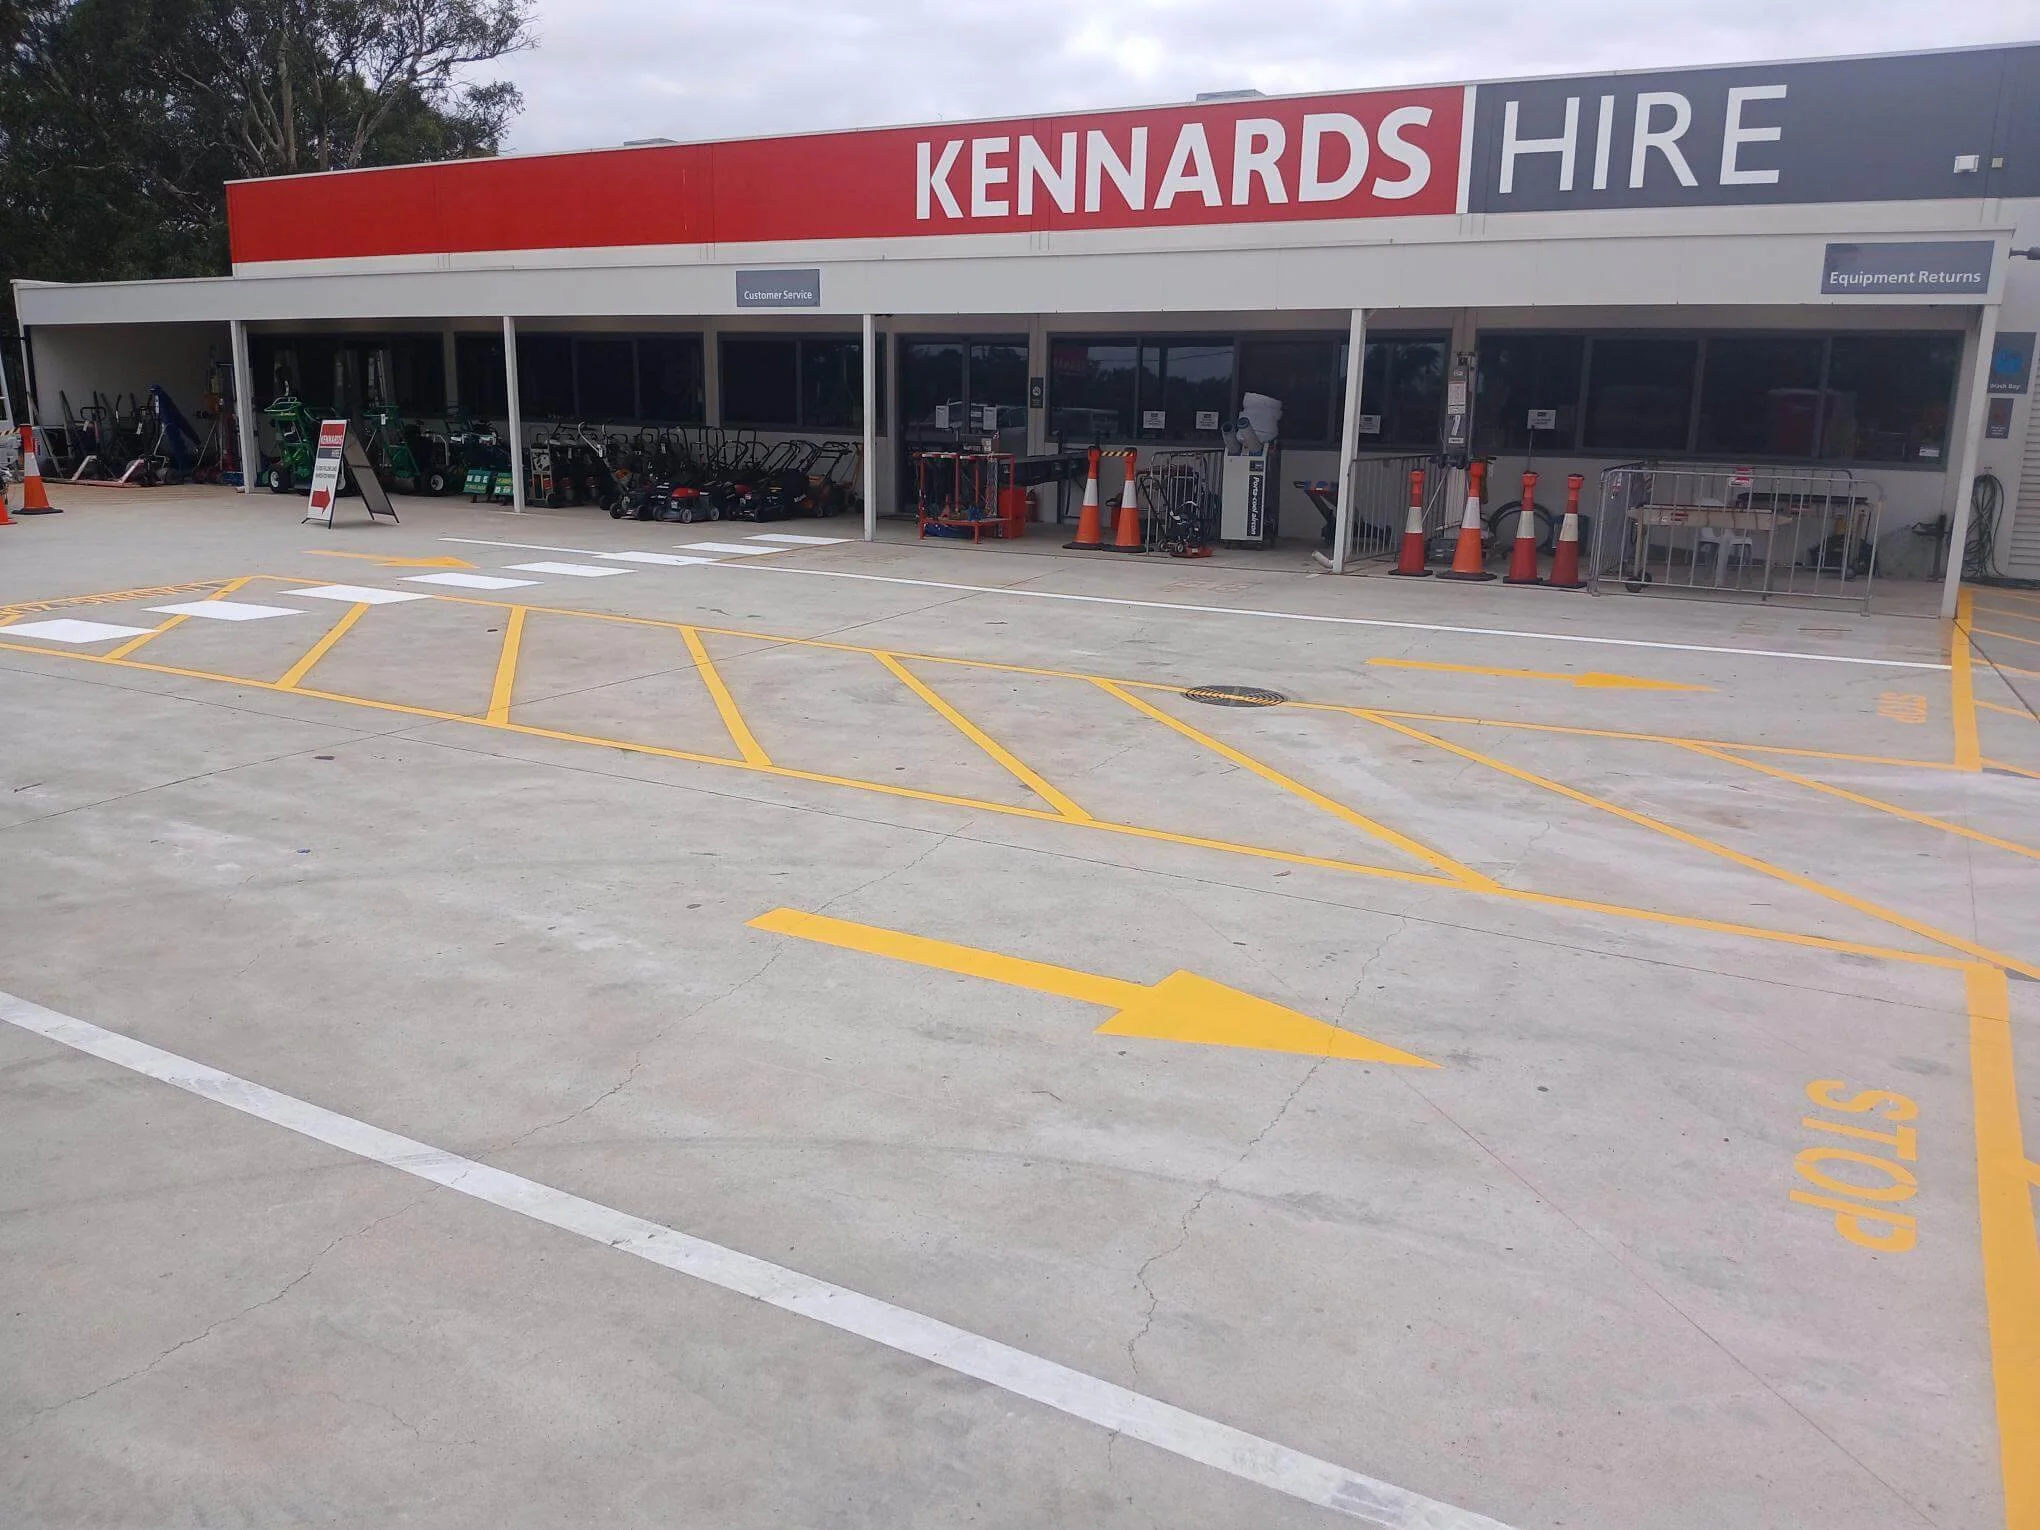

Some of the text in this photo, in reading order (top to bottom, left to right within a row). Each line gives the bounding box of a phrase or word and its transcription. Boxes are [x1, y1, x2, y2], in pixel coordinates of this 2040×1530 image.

[916, 84, 1787, 219] KENNARDS HIRE
[744, 289, 813, 300] Customer Service
[1830, 270, 1981, 287] Equipment Returns
[1789, 1079, 1919, 1252] STOP
